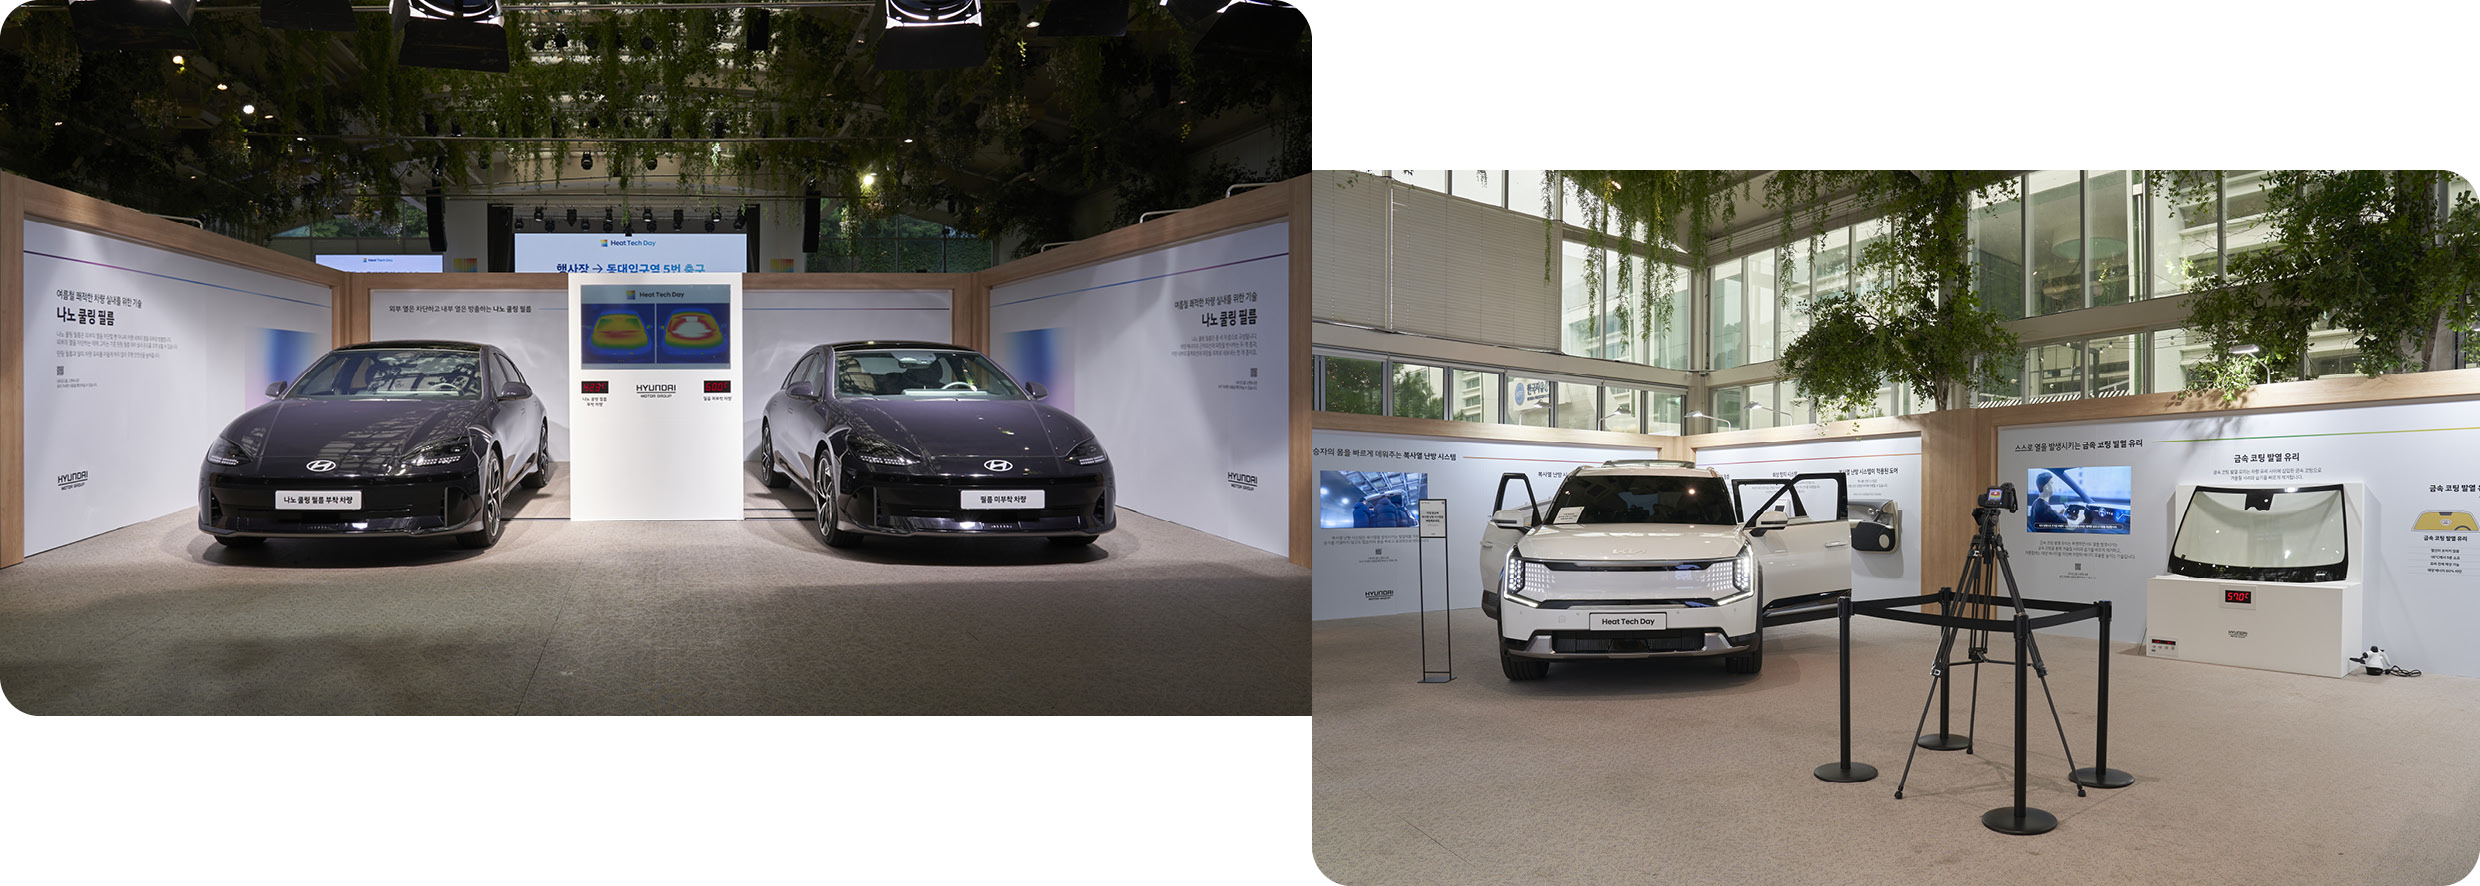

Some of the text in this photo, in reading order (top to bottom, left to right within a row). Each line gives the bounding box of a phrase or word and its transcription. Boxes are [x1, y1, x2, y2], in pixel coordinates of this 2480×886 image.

[57, 290, 142, 308] 여름철 쾌적한 차량 실내를 위한 기술
[1174, 300, 1188, 310] 여름철
[1205, 297, 1215, 306] 차량
[1217, 295, 1232, 305] 실내를
[1233, 292, 1244, 303] 위한
[1246, 292, 1257, 302] 기술
[57, 307, 114, 326] 나노 쿨링 필름
[1202, 308, 1257, 327] 나노 쿨링 필름
[2034, 443, 2047, 452] 열을
[2049, 442, 2081, 451] 발생시키는
[2098, 441, 2111, 449] 코팅
[2128, 439, 2143, 447] 유리
[1337, 448, 1350, 456] 몸을
[1375, 450, 1402, 459] 데워주는
[1403, 452, 1422, 460] 복사열
[1438, 453, 1456, 461] 시스템
[2234, 453, 2300, 463] 금속 코팅 발열 유리
[58, 471, 88, 483] HYUNDAI
[1228, 472, 1257, 484] HYUNDAI
